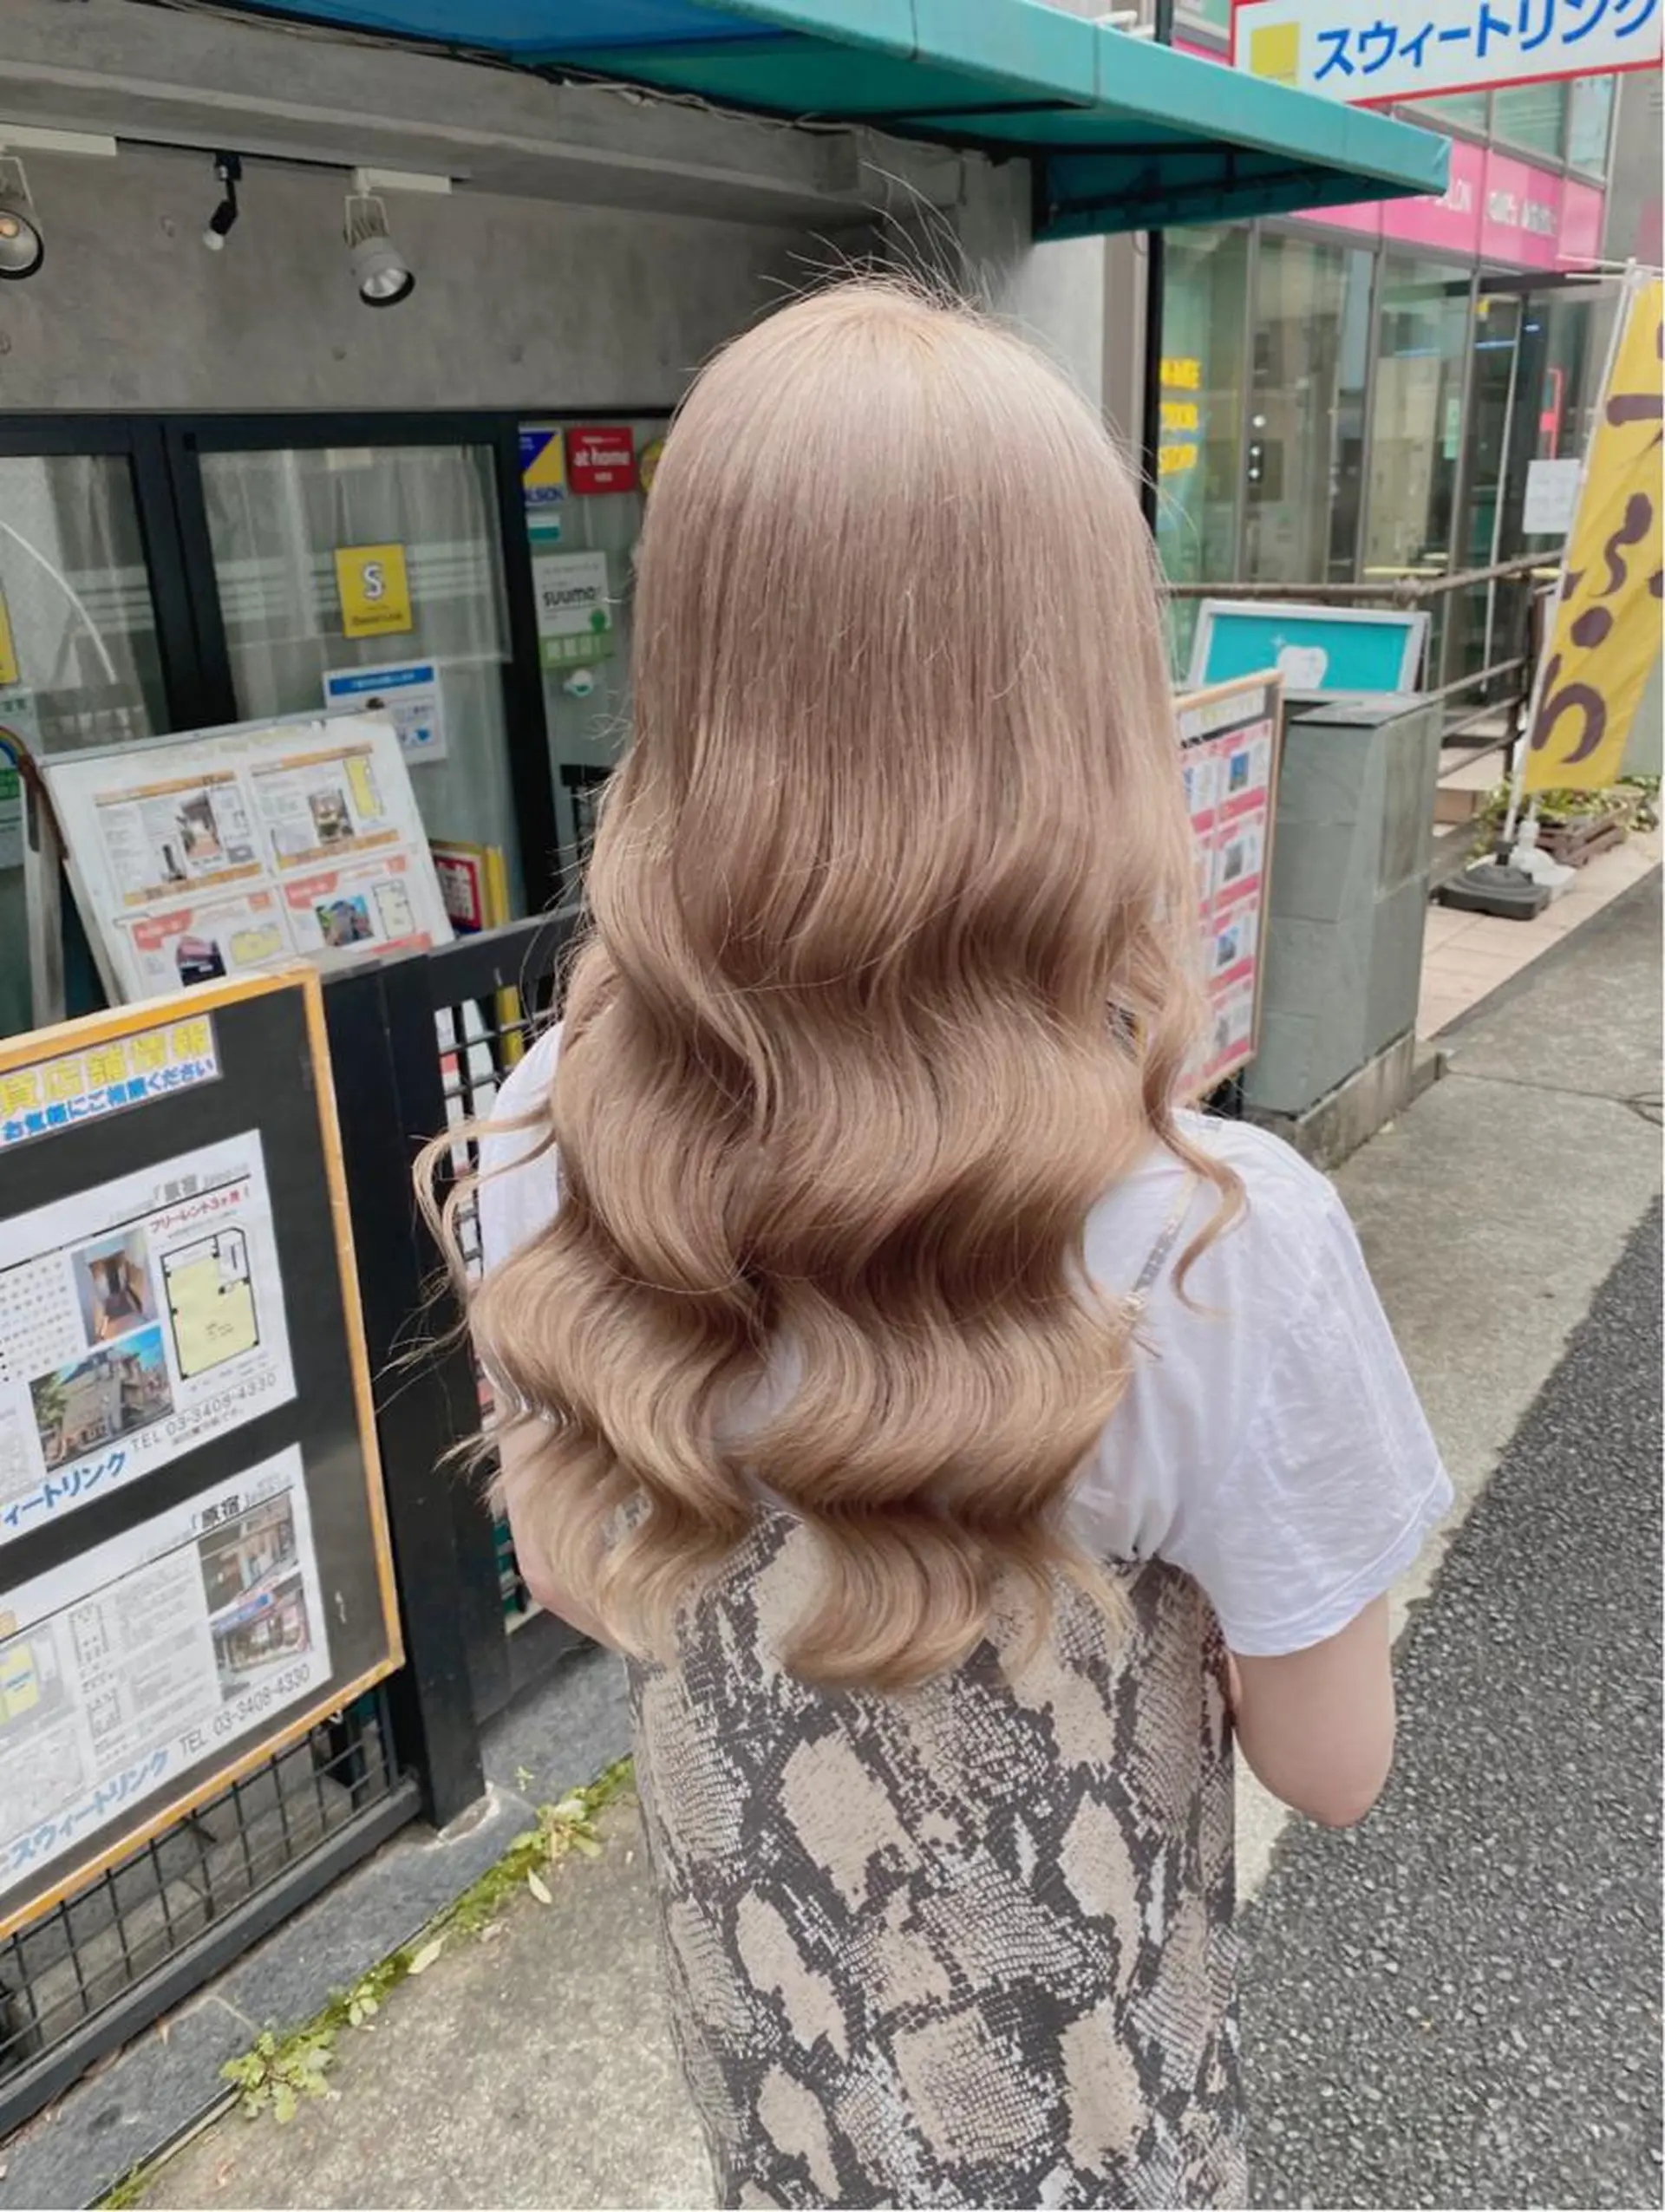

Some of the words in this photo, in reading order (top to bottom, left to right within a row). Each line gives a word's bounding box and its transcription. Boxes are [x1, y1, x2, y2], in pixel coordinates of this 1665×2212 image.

[362, 561, 385, 601] S
[130, 1428, 162, 1452] TEL
[178, 1729, 209, 1757] TEL
